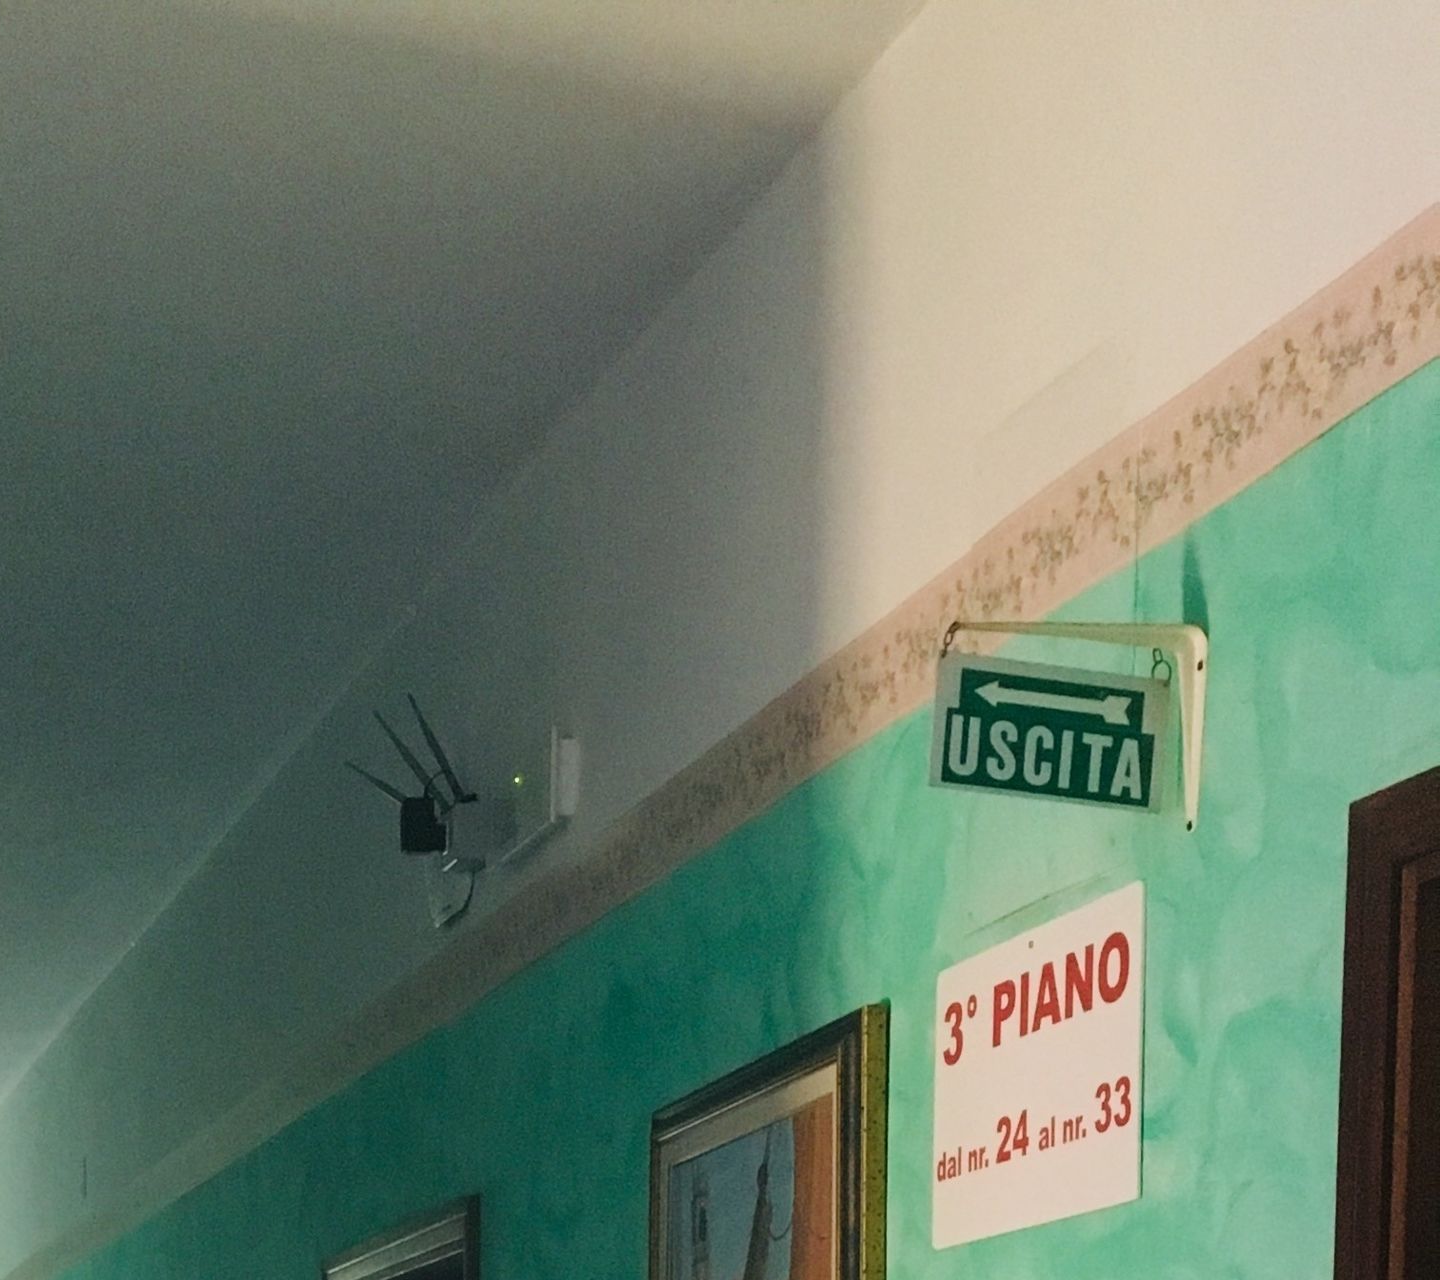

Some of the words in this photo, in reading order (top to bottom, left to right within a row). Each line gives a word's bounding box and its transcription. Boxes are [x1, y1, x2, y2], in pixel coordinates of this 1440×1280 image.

[947, 714, 1143, 799] USCITA
[943, 994, 977, 1066] 3°
[992, 931, 1130, 1048] PIANO
[937, 1146, 962, 1182] dal
[968, 1146, 989, 1173] nr.
[995, 1109, 1029, 1164] 24
[1038, 1116, 1056, 1151] al
[1062, 1115, 1086, 1144] nr.
[1094, 1076, 1131, 1133] 33
